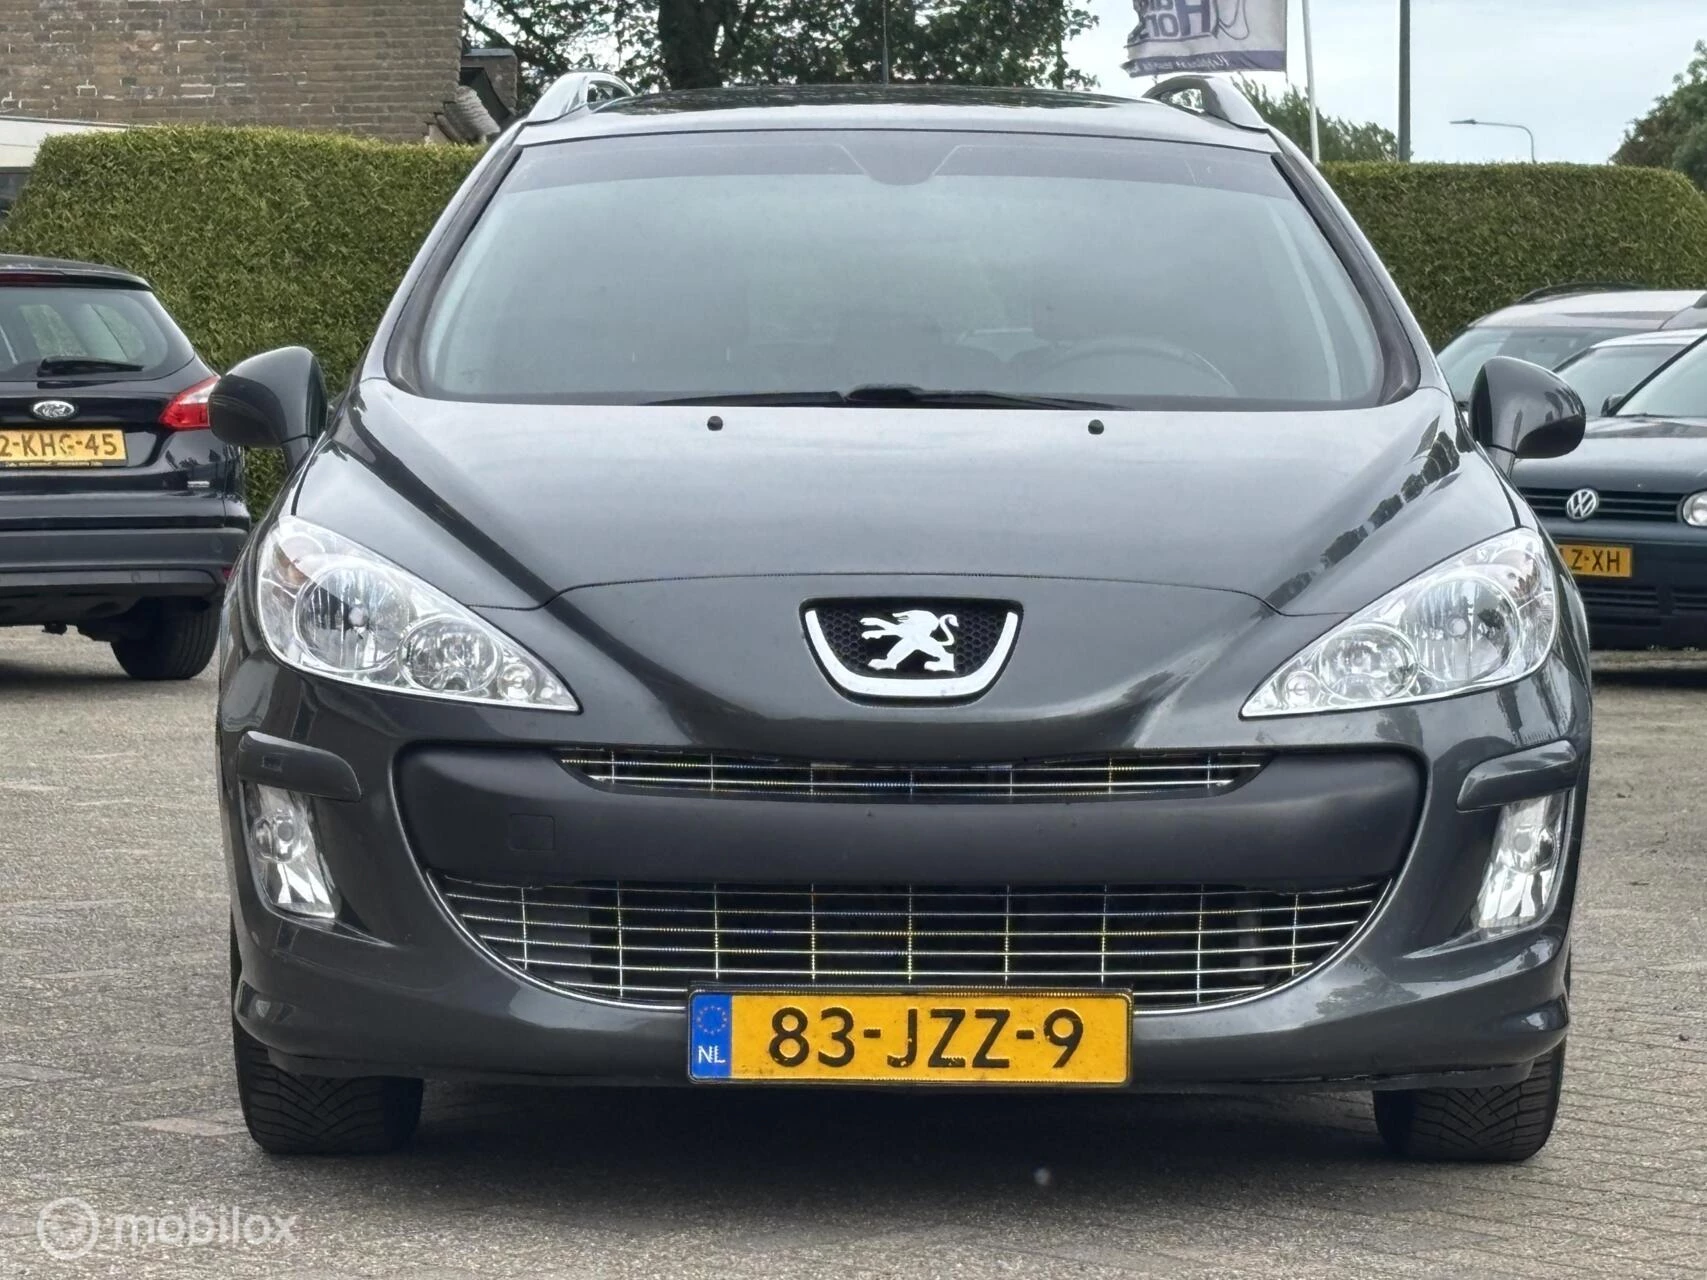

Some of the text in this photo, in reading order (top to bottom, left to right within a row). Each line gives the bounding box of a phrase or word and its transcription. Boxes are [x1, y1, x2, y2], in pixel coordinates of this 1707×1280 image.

[1560, 548, 1620, 573] Z-XH
[768, 1007, 1084, 1069] 83-JZZ-9
[698, 1045, 726, 1064] NL
